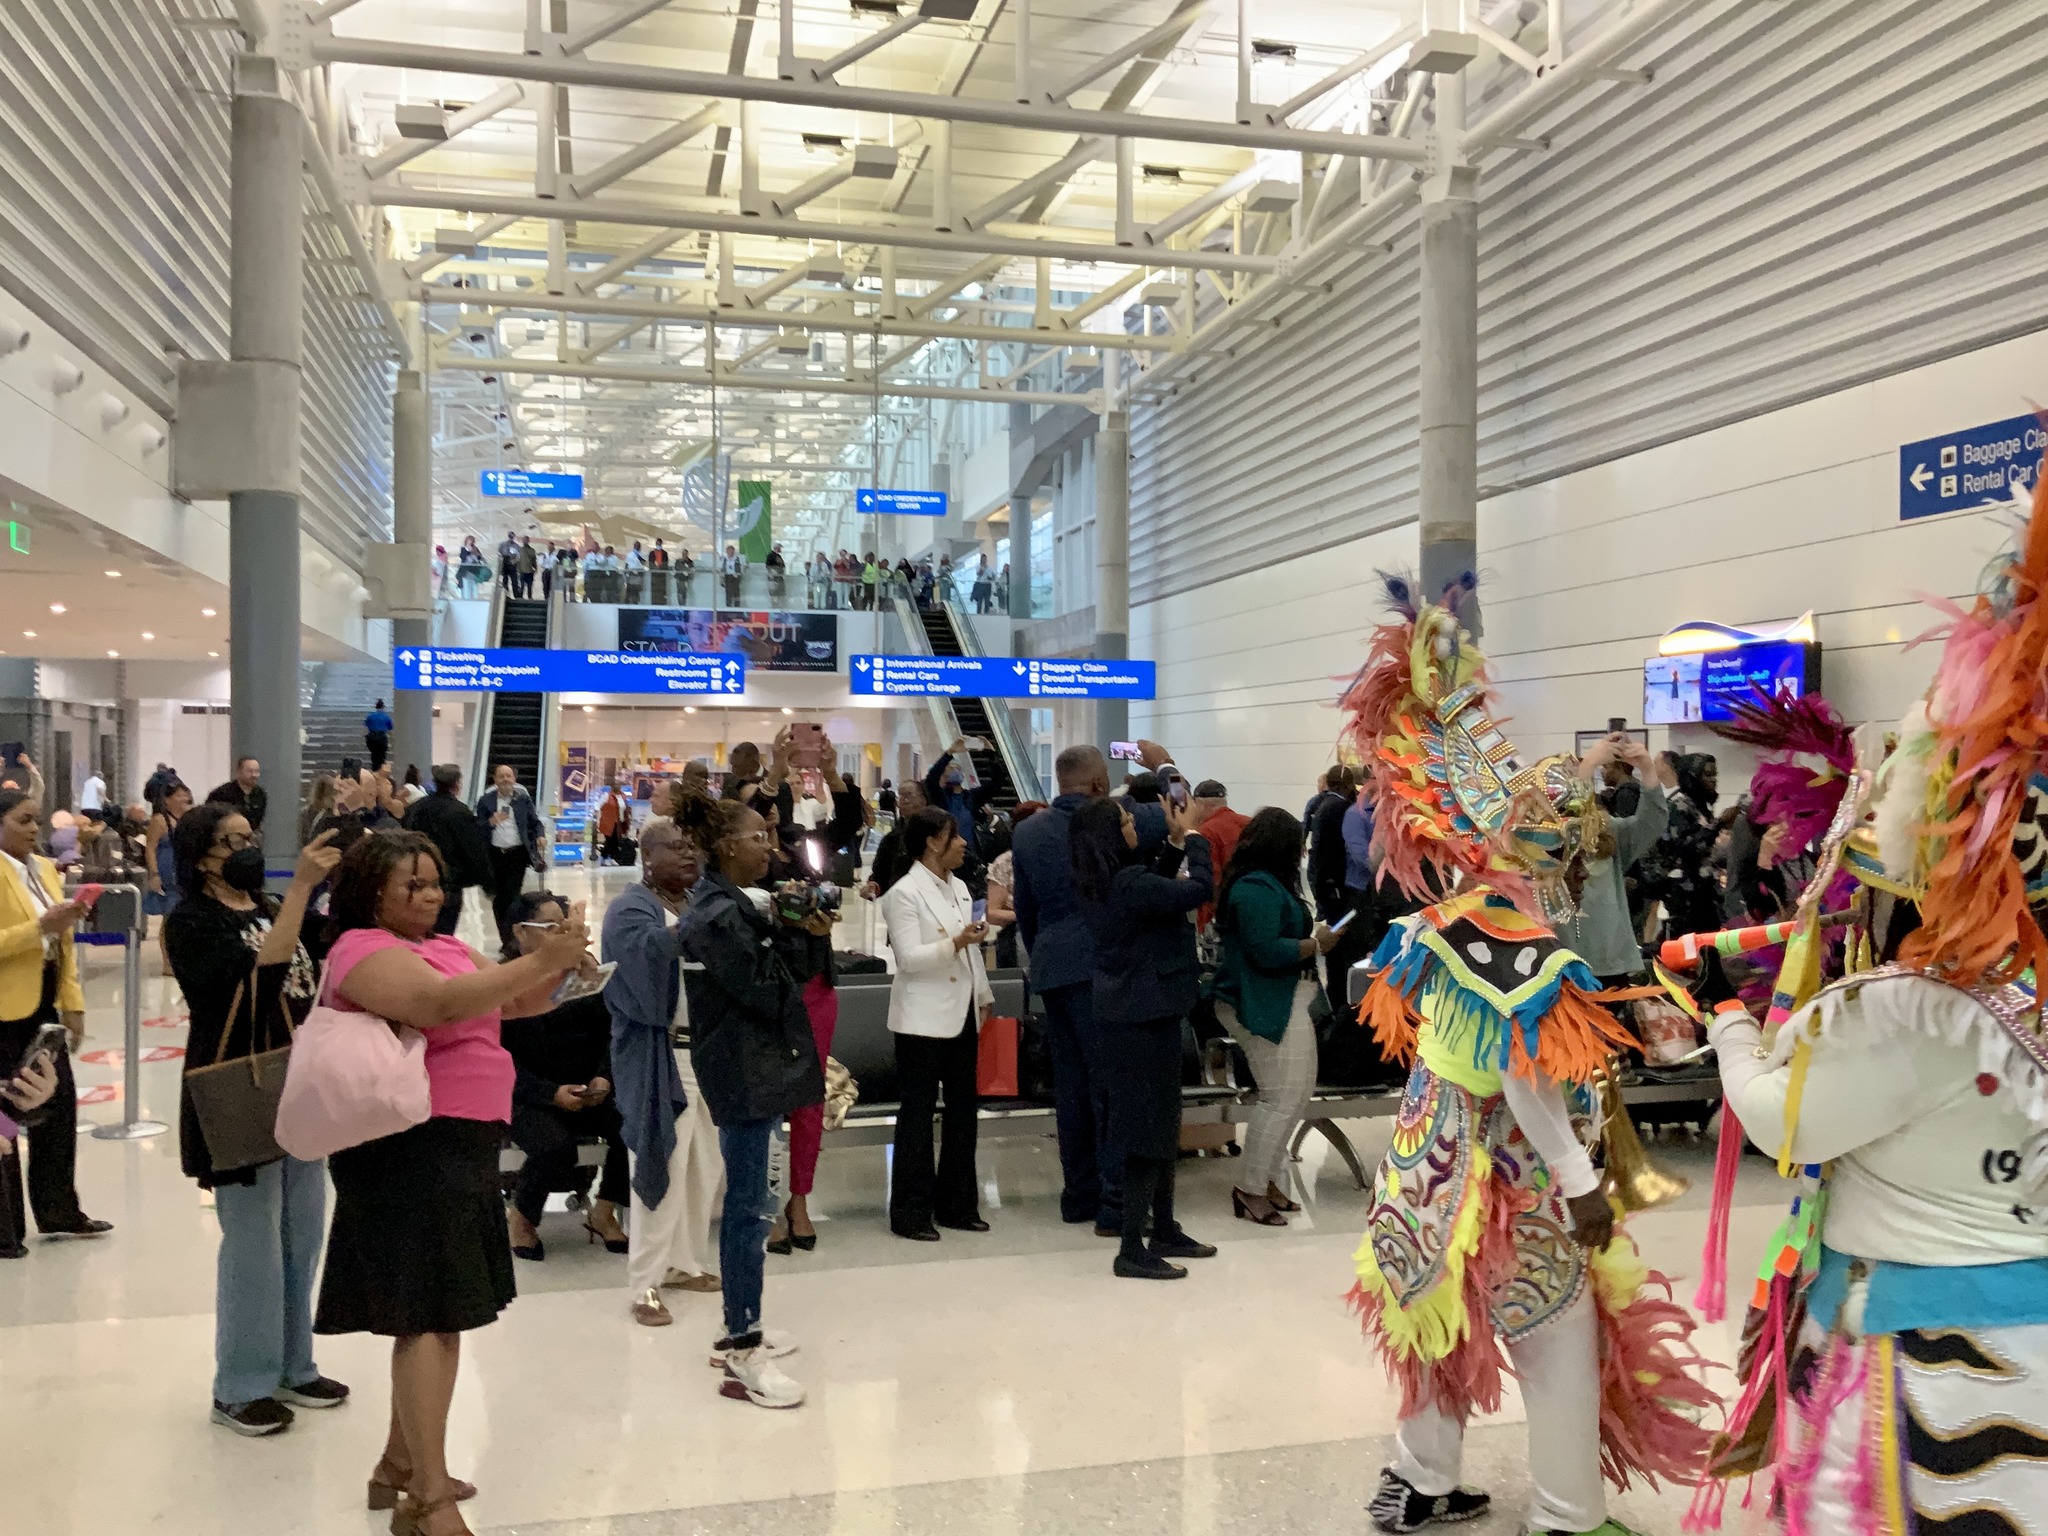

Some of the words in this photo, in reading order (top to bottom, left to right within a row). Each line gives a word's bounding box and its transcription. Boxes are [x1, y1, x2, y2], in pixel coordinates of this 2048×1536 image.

[1963, 437, 2022, 465] Baggage
[1963, 467, 2005, 494] Rental
[2008, 464, 2033, 484] Car
[895, 502, 921, 510] CENTER
[434, 651, 486, 664] Ticketing
[587, 654, 619, 664] BCAD
[620, 655, 687, 667] Credentialing
[688, 656, 722, 666] Center
[434, 663, 479, 676] Security
[479, 664, 540, 676] Checkpoint
[886, 659, 946, 669] International
[947, 660, 982, 670] Arrivals
[1042, 662, 1081, 673] Baggage
[1082, 663, 1108, 672] Claim
[655, 667, 708, 678] Restrooms
[886, 670, 916, 680] Rental
[917, 671, 940, 680] Cars
[434, 676, 467, 687] Gates
[469, 676, 503, 687] A-B-C
[1041, 673, 1075, 683] Ground
[1076, 674, 1139, 685] Transportation
[668, 680, 708, 690] Elevator
[886, 682, 925, 693] Cypress
[927, 683, 961, 694] Garage
[1042, 685, 1088, 695] Restrooms
